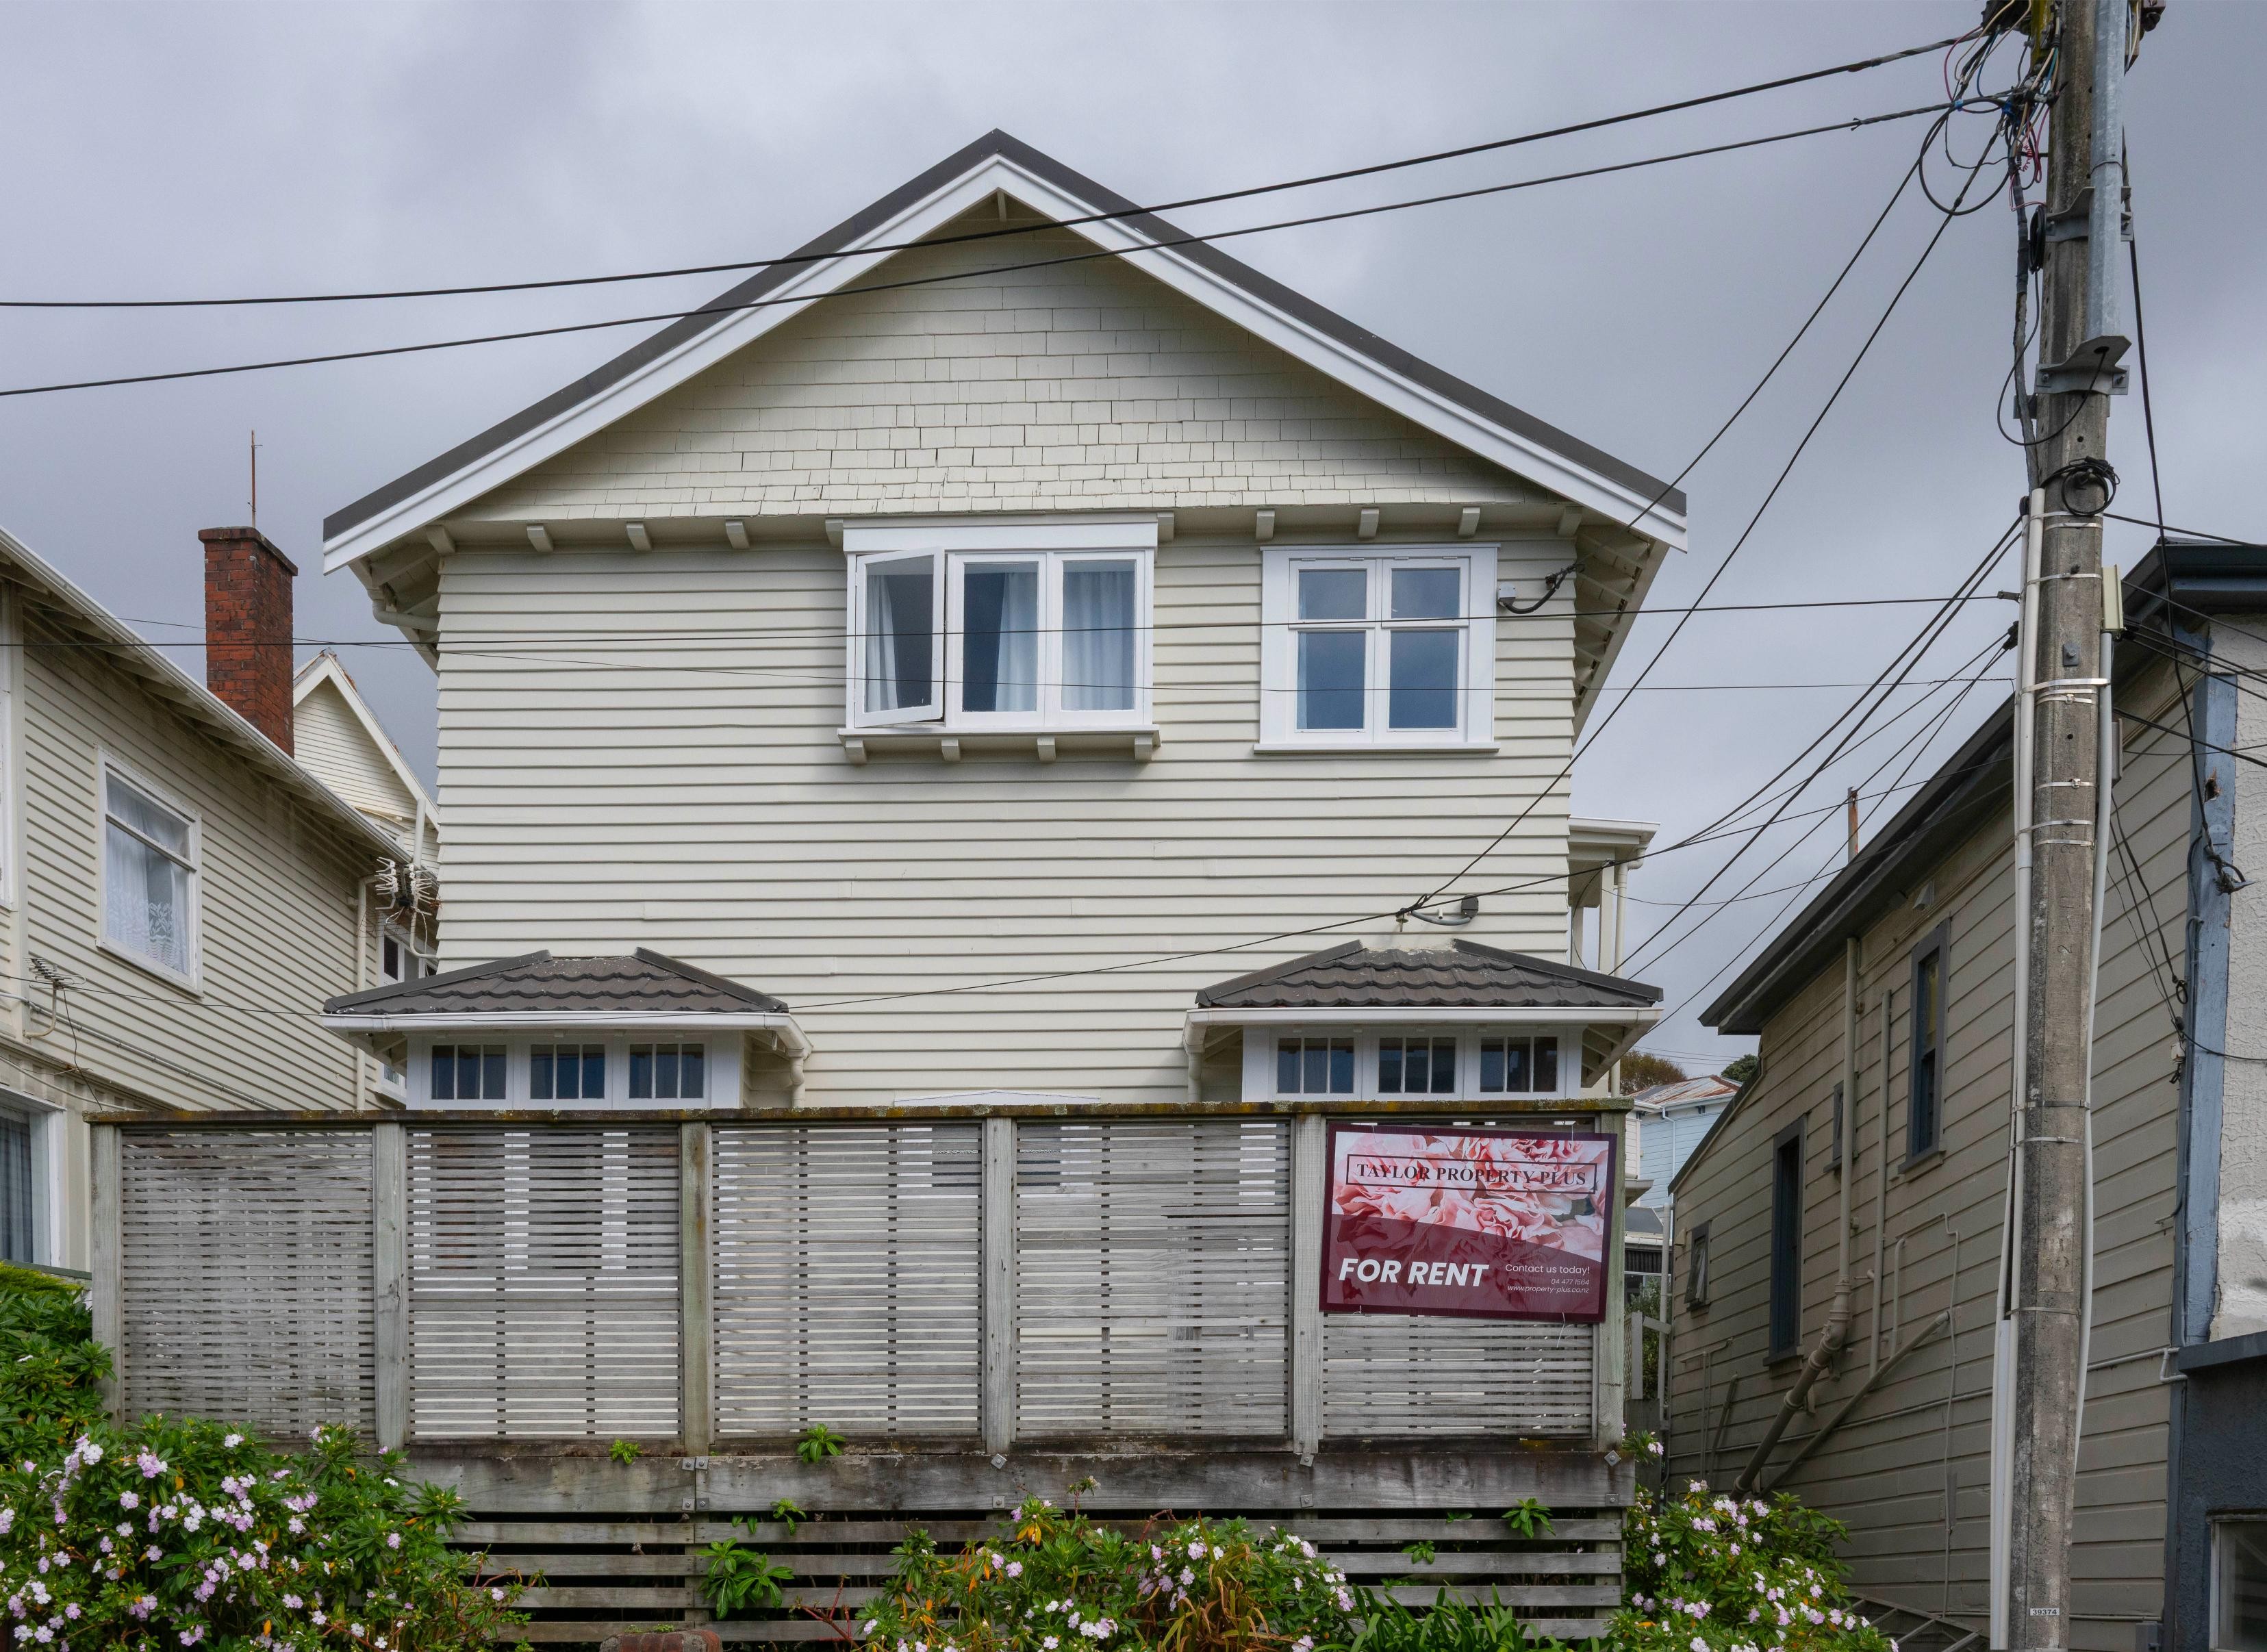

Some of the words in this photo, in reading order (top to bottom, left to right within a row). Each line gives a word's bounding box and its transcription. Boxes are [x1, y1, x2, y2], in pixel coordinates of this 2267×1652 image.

[1356, 1163, 1431, 1180] TAYLOR
[1436, 1167, 1536, 1184] PROPERTY
[1539, 1171, 1586, 1186] PLUS
[1339, 1258, 1402, 1284] FOR
[1407, 1261, 1490, 1287] RENT
[1505, 1264, 1544, 1273] Contact
[1560, 1265, 1590, 1275] today!
[1507, 1285, 1589, 1293] www.property-plus.co.nz
